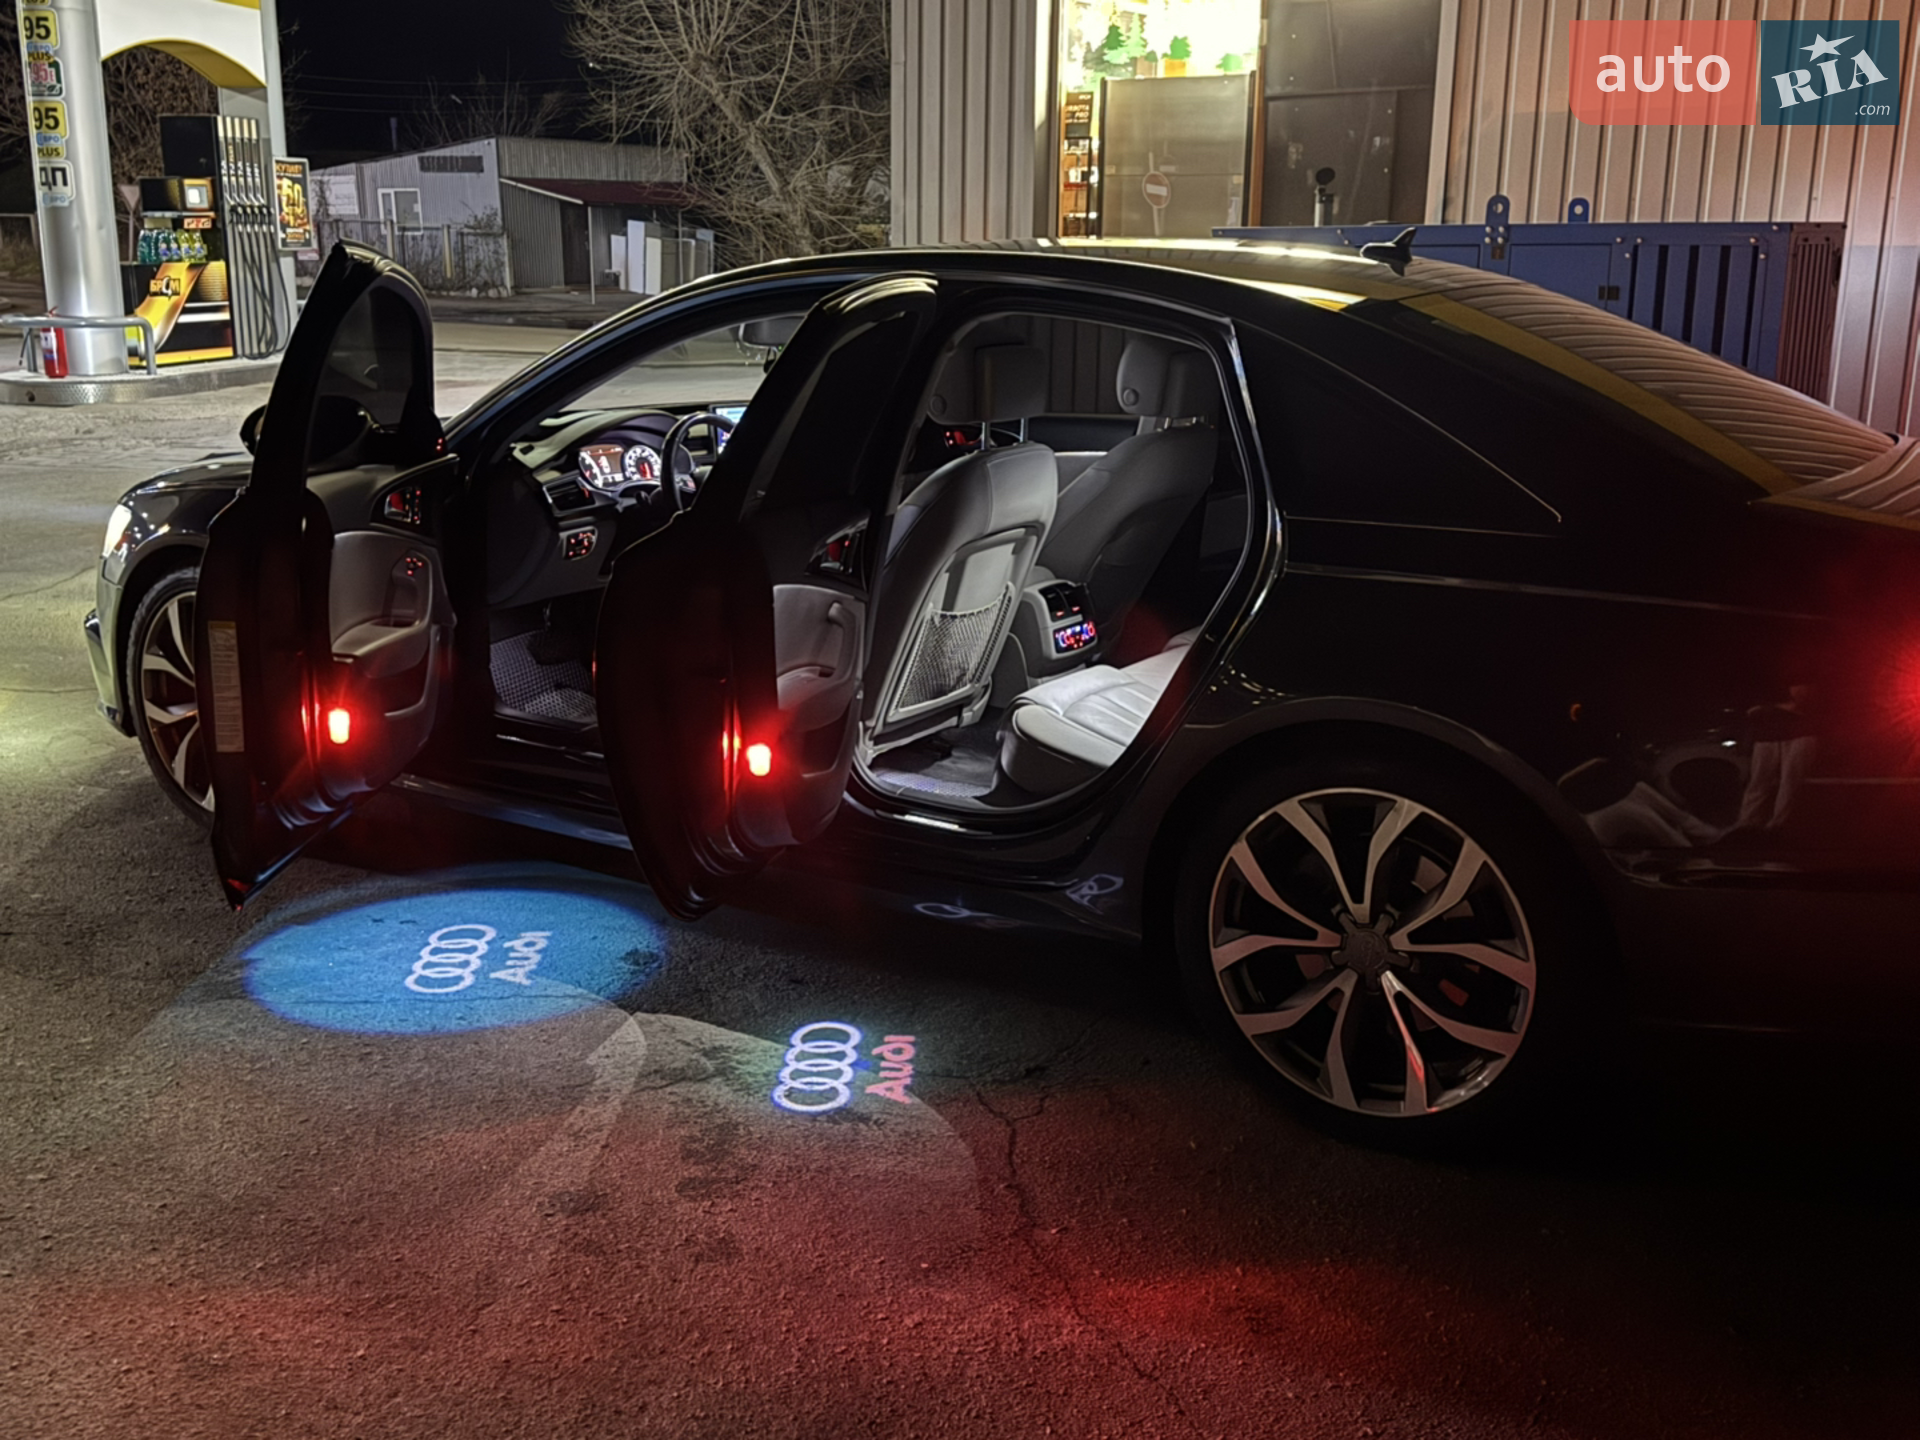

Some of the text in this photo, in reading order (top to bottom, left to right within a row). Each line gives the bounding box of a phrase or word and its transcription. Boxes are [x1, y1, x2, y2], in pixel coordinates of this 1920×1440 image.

[23, 16, 51, 40] 95
[33, 107, 60, 130] 95
[37, 147, 61, 157] PLUS
[39, 166, 69, 192] ДП
[489, 930, 554, 985] Audi
[864, 1034, 916, 1104] Audi
